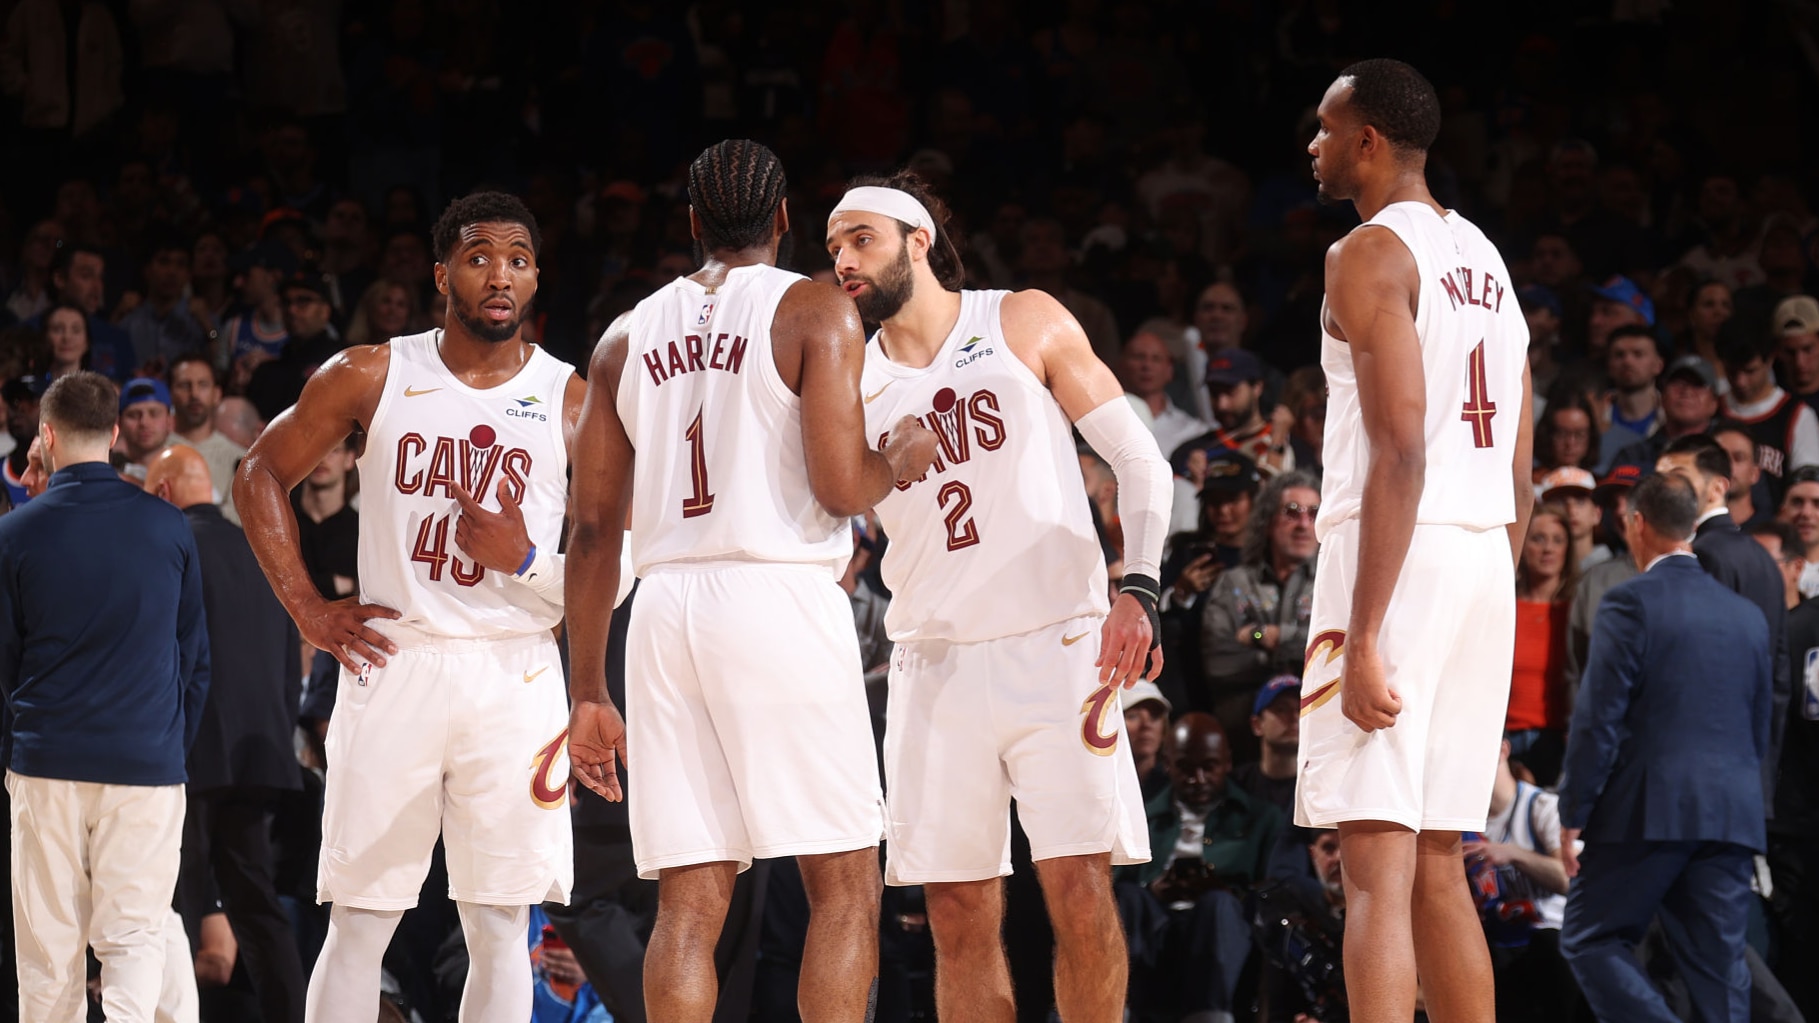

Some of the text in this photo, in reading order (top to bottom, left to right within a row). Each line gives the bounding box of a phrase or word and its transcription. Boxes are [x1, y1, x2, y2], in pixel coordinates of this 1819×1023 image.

[1440, 266, 1504, 314] MLEY
[643, 332, 749, 387] HAREN
[955, 347, 994, 369] CLIFFS
[506, 408, 547, 422] CLIFFS
[1461, 337, 1496, 448] 4
[395, 425, 533, 510] CAVS
[683, 400, 716, 519] 1
[937, 480, 980, 552] 2
